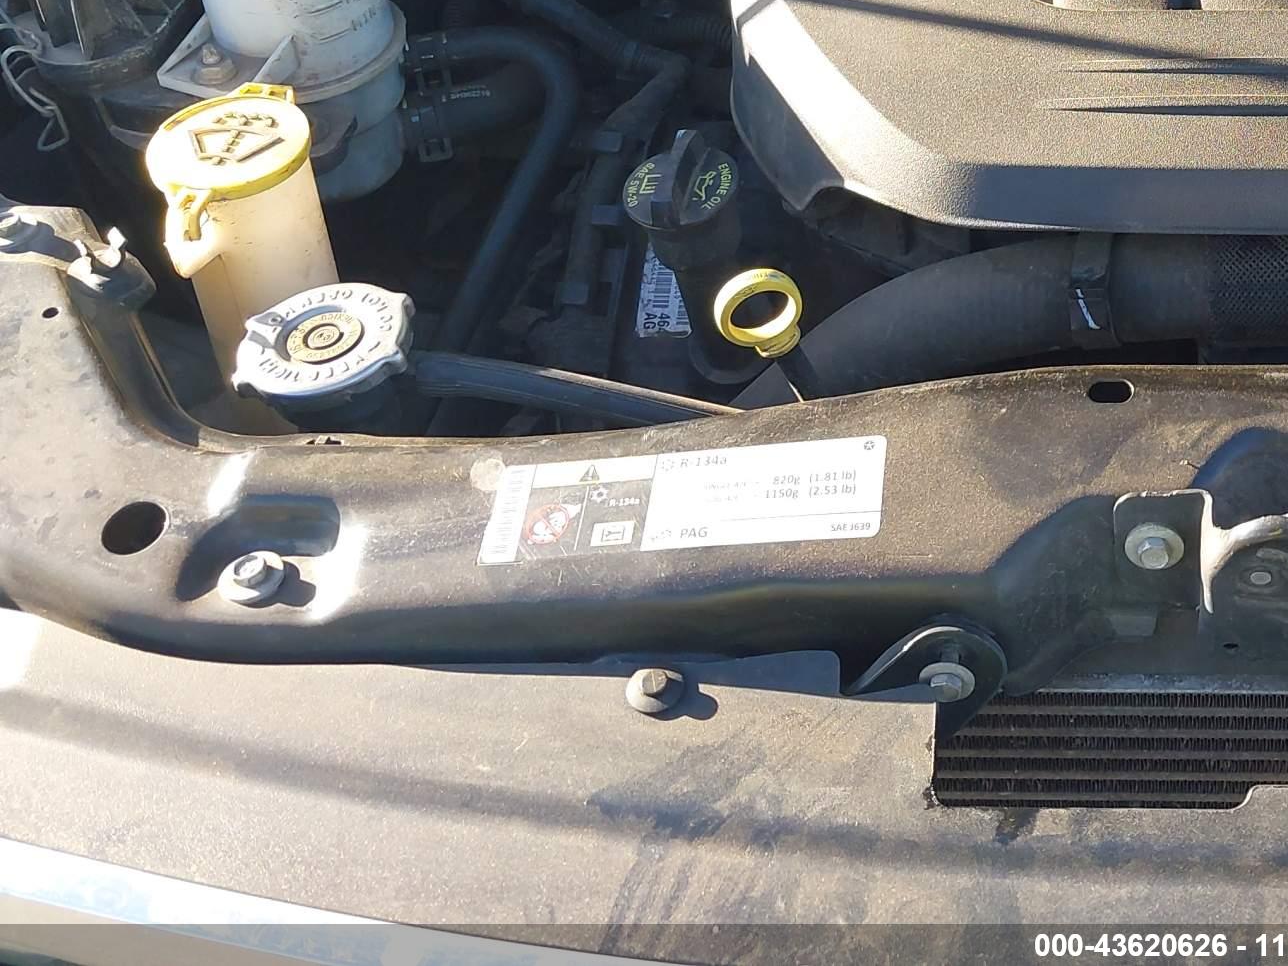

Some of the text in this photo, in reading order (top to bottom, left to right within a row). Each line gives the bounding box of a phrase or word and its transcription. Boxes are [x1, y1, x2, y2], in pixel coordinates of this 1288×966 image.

[634, 162, 656, 179] SAE
[701, 162, 732, 210] ENGINE OIL
[772, 469, 857, 486] 820g (1.81 lb)
[765, 483, 857, 499] 1150g (2.53 lb)
[609, 497, 641, 507] R-134a
[679, 526, 708, 539] PAG
[831, 523, 847, 532] SAE
